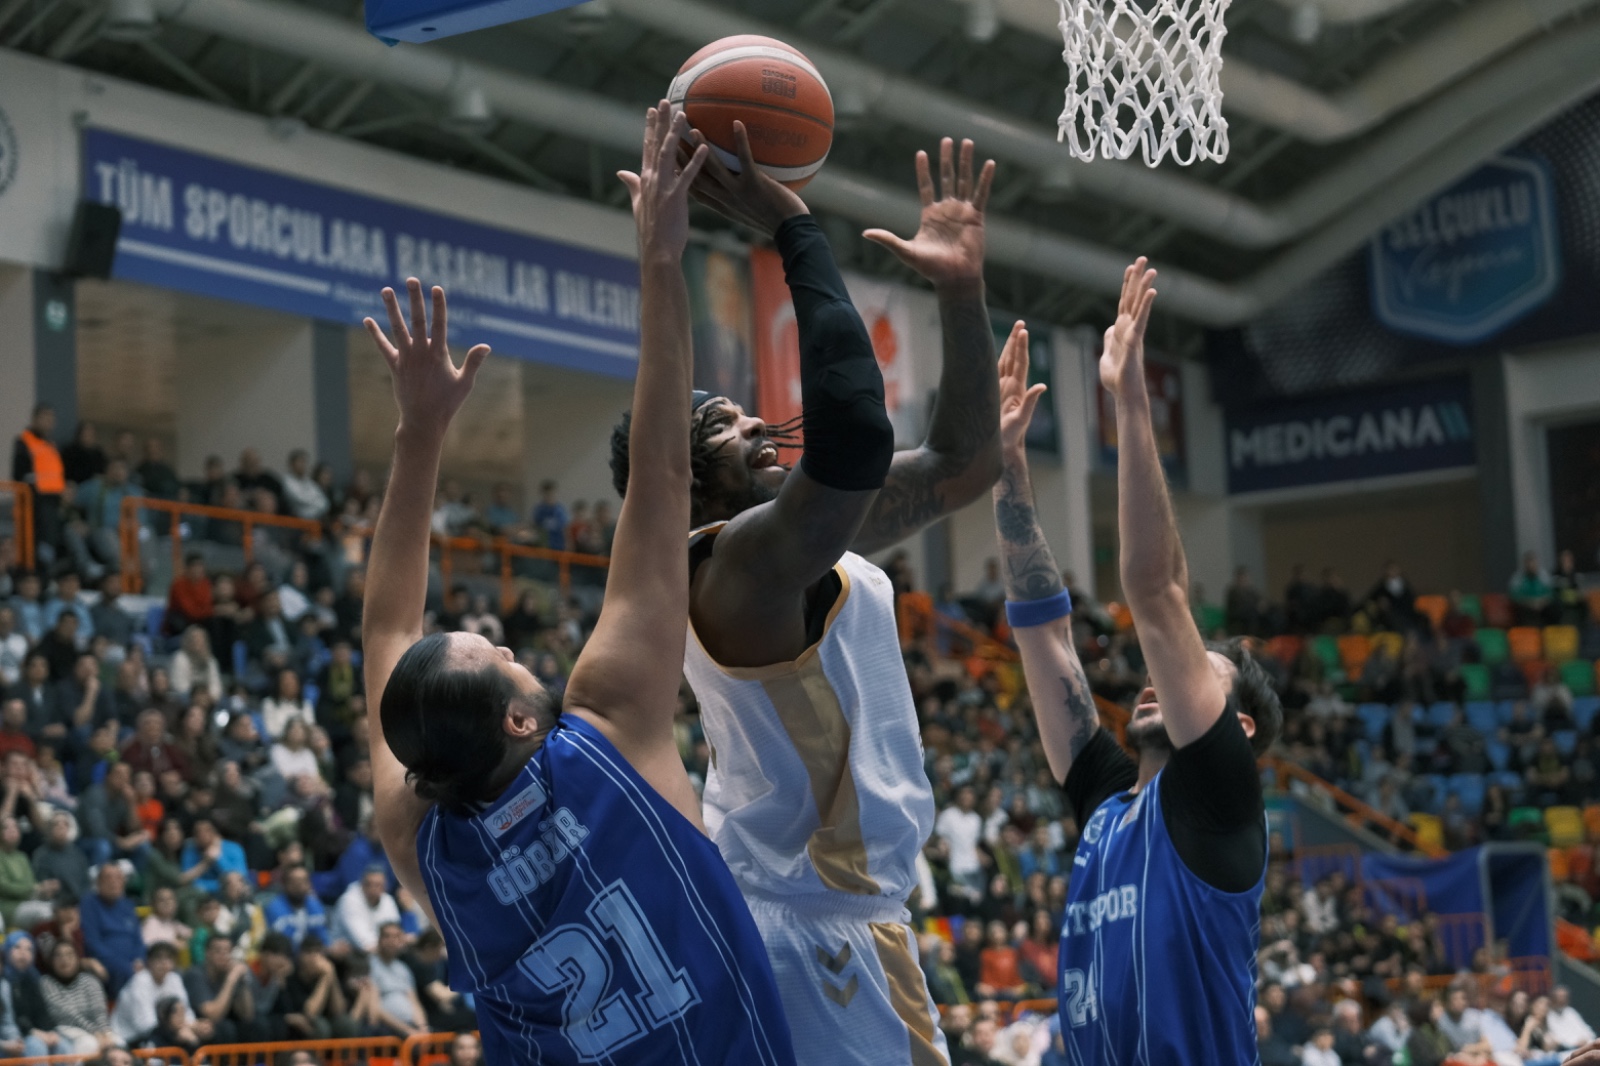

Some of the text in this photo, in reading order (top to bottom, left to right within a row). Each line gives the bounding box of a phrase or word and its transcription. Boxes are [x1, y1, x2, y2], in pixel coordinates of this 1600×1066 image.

[761, 76, 798, 100] FIBA
[729, 122, 810, 149] molte
[95, 157, 173, 231] TÜM
[184, 183, 389, 278] SPORCULARA
[1231, 404, 1445, 469] MEDICANA
[516, 878, 702, 1063] 21
[1064, 961, 1098, 1029] 24
